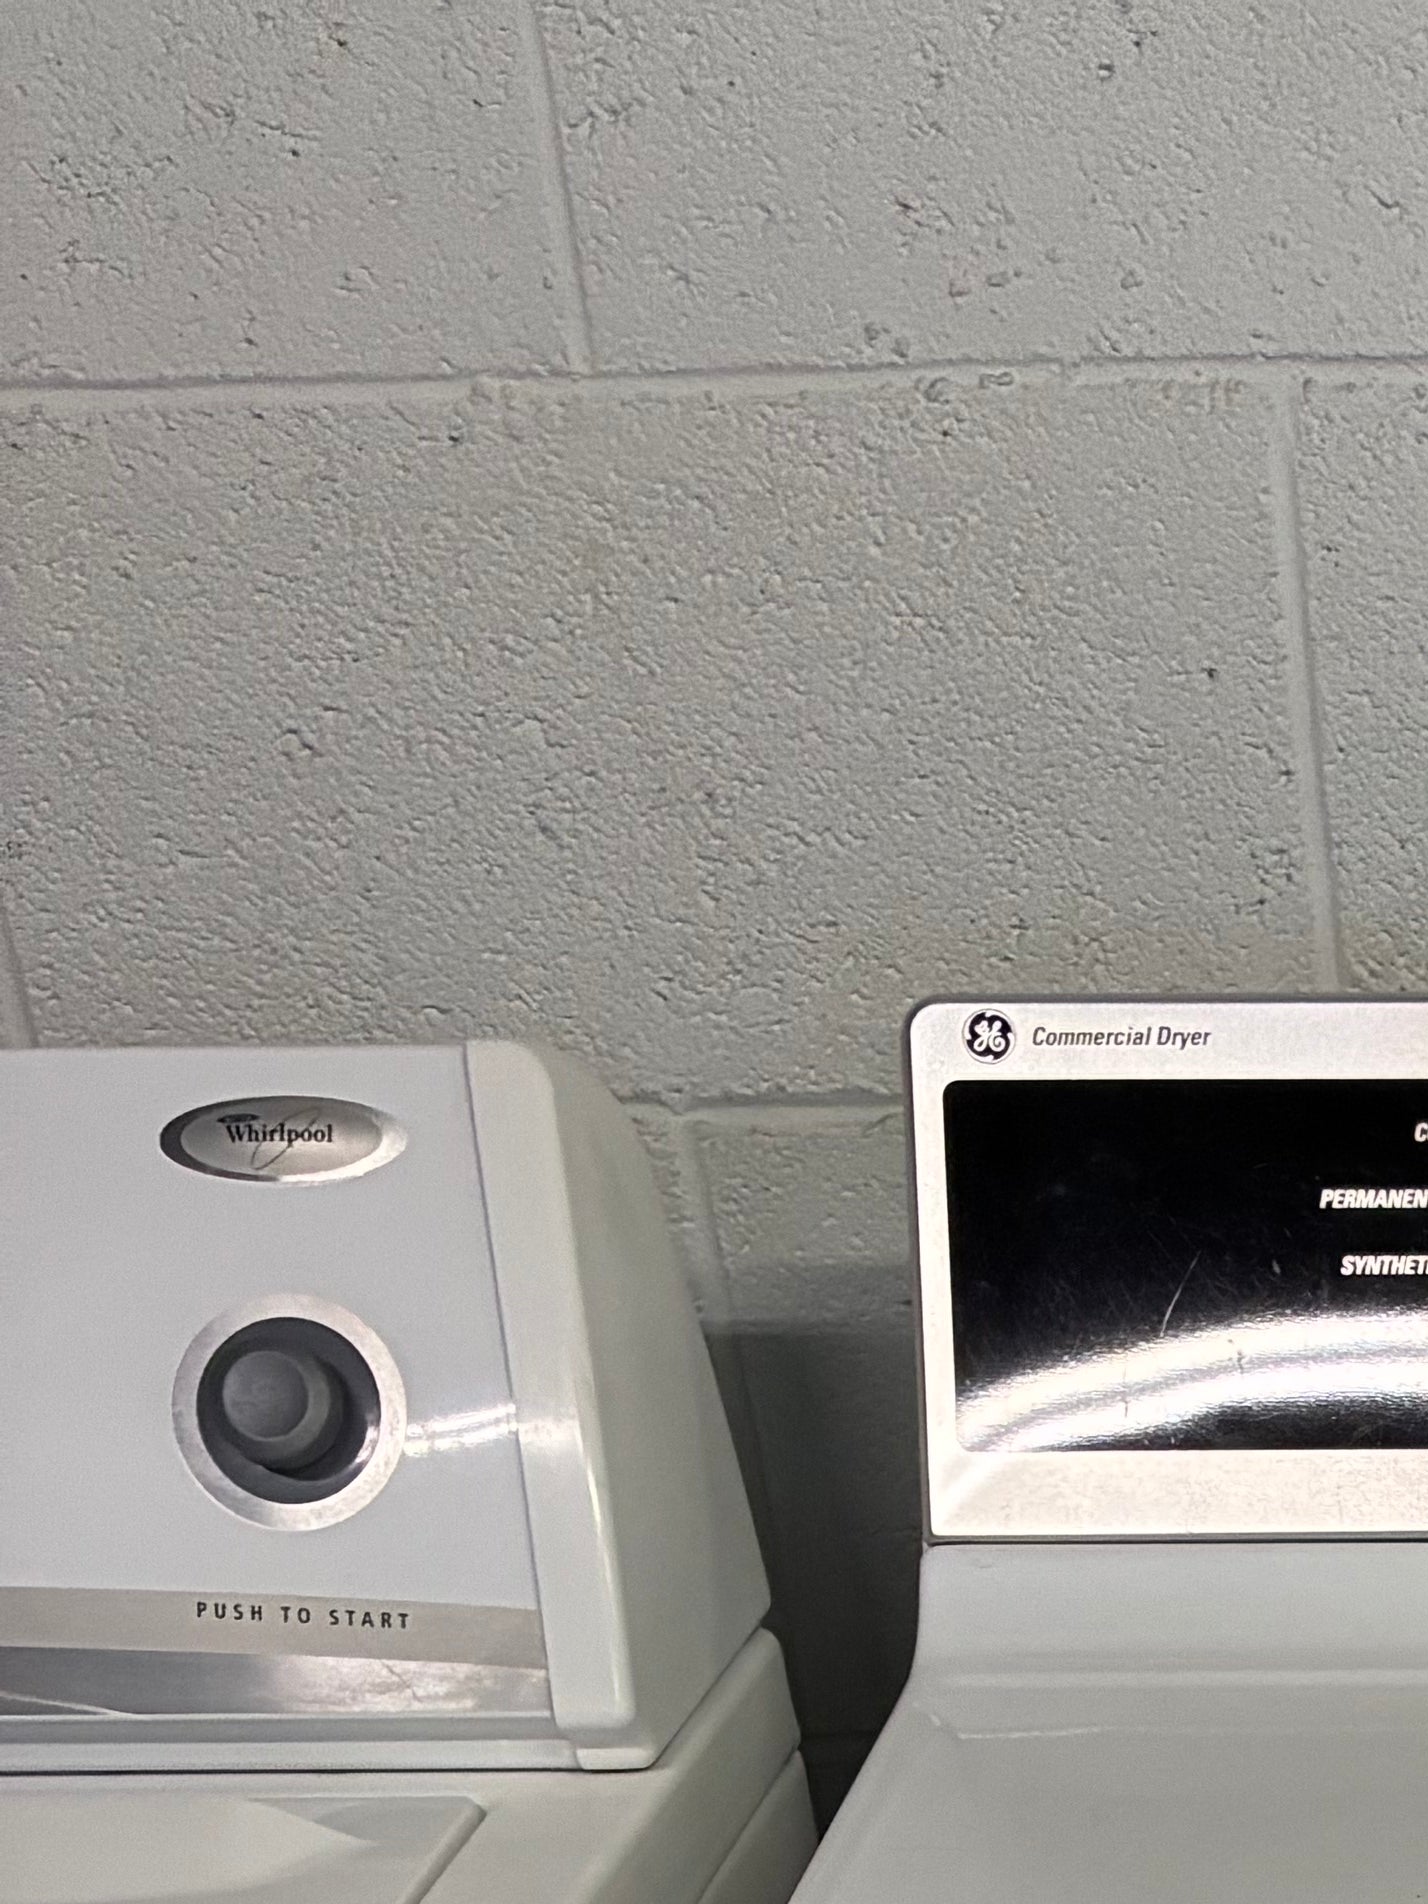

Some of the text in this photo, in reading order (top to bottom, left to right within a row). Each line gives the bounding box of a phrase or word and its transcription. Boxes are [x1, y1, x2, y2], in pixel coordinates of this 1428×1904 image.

[1031, 1026, 1212, 1050] Commercial Dryer
[226, 1122, 333, 1148] Whirlpool
[196, 1601, 409, 1629] PUSH TO START
